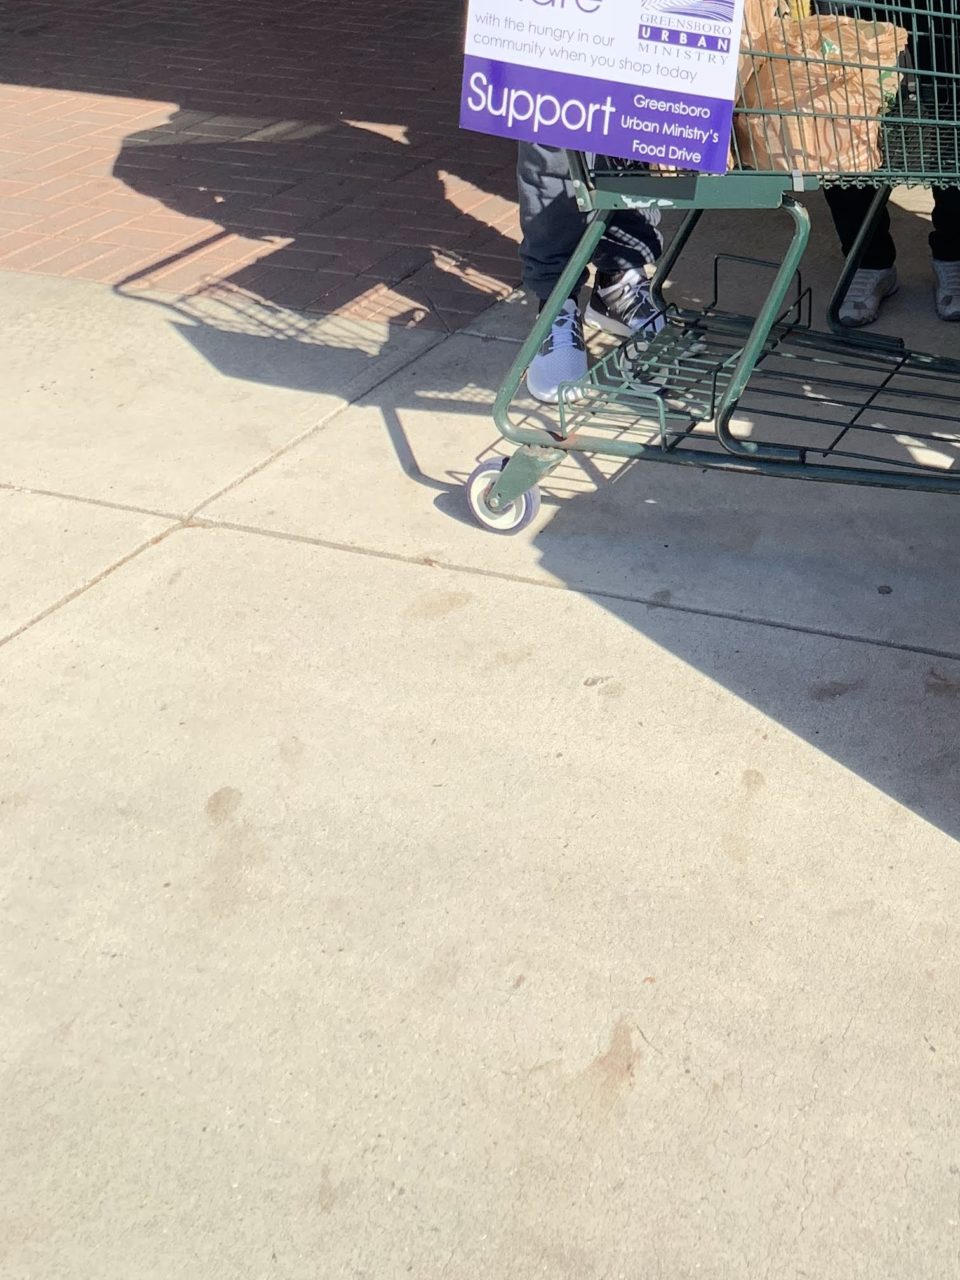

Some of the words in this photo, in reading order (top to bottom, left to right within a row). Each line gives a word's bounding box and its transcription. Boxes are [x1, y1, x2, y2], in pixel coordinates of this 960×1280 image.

[474, 12, 501, 31] with
[504, 15, 525, 34] the
[528, 19, 576, 45] hungry
[578, 27, 589, 42] in
[592, 34, 615, 47] our
[639, 13, 732, 36] GREENSBORO
[641, 27, 729, 51] URBAN
[473, 31, 546, 59] community
[549, 42, 587, 63] when
[590, 53, 616, 73] you
[618, 56, 652, 77] shop
[655, 61, 698, 84] today
[638, 42, 729, 66] MINISTRY
[467, 71, 616, 136] Support
[633, 94, 711, 119] Greensboro
[621, 114, 659, 134] Urban
[662, 121, 719, 144] Ministry's
[632, 139, 665, 159] Food
[668, 144, 702, 164] Drive
